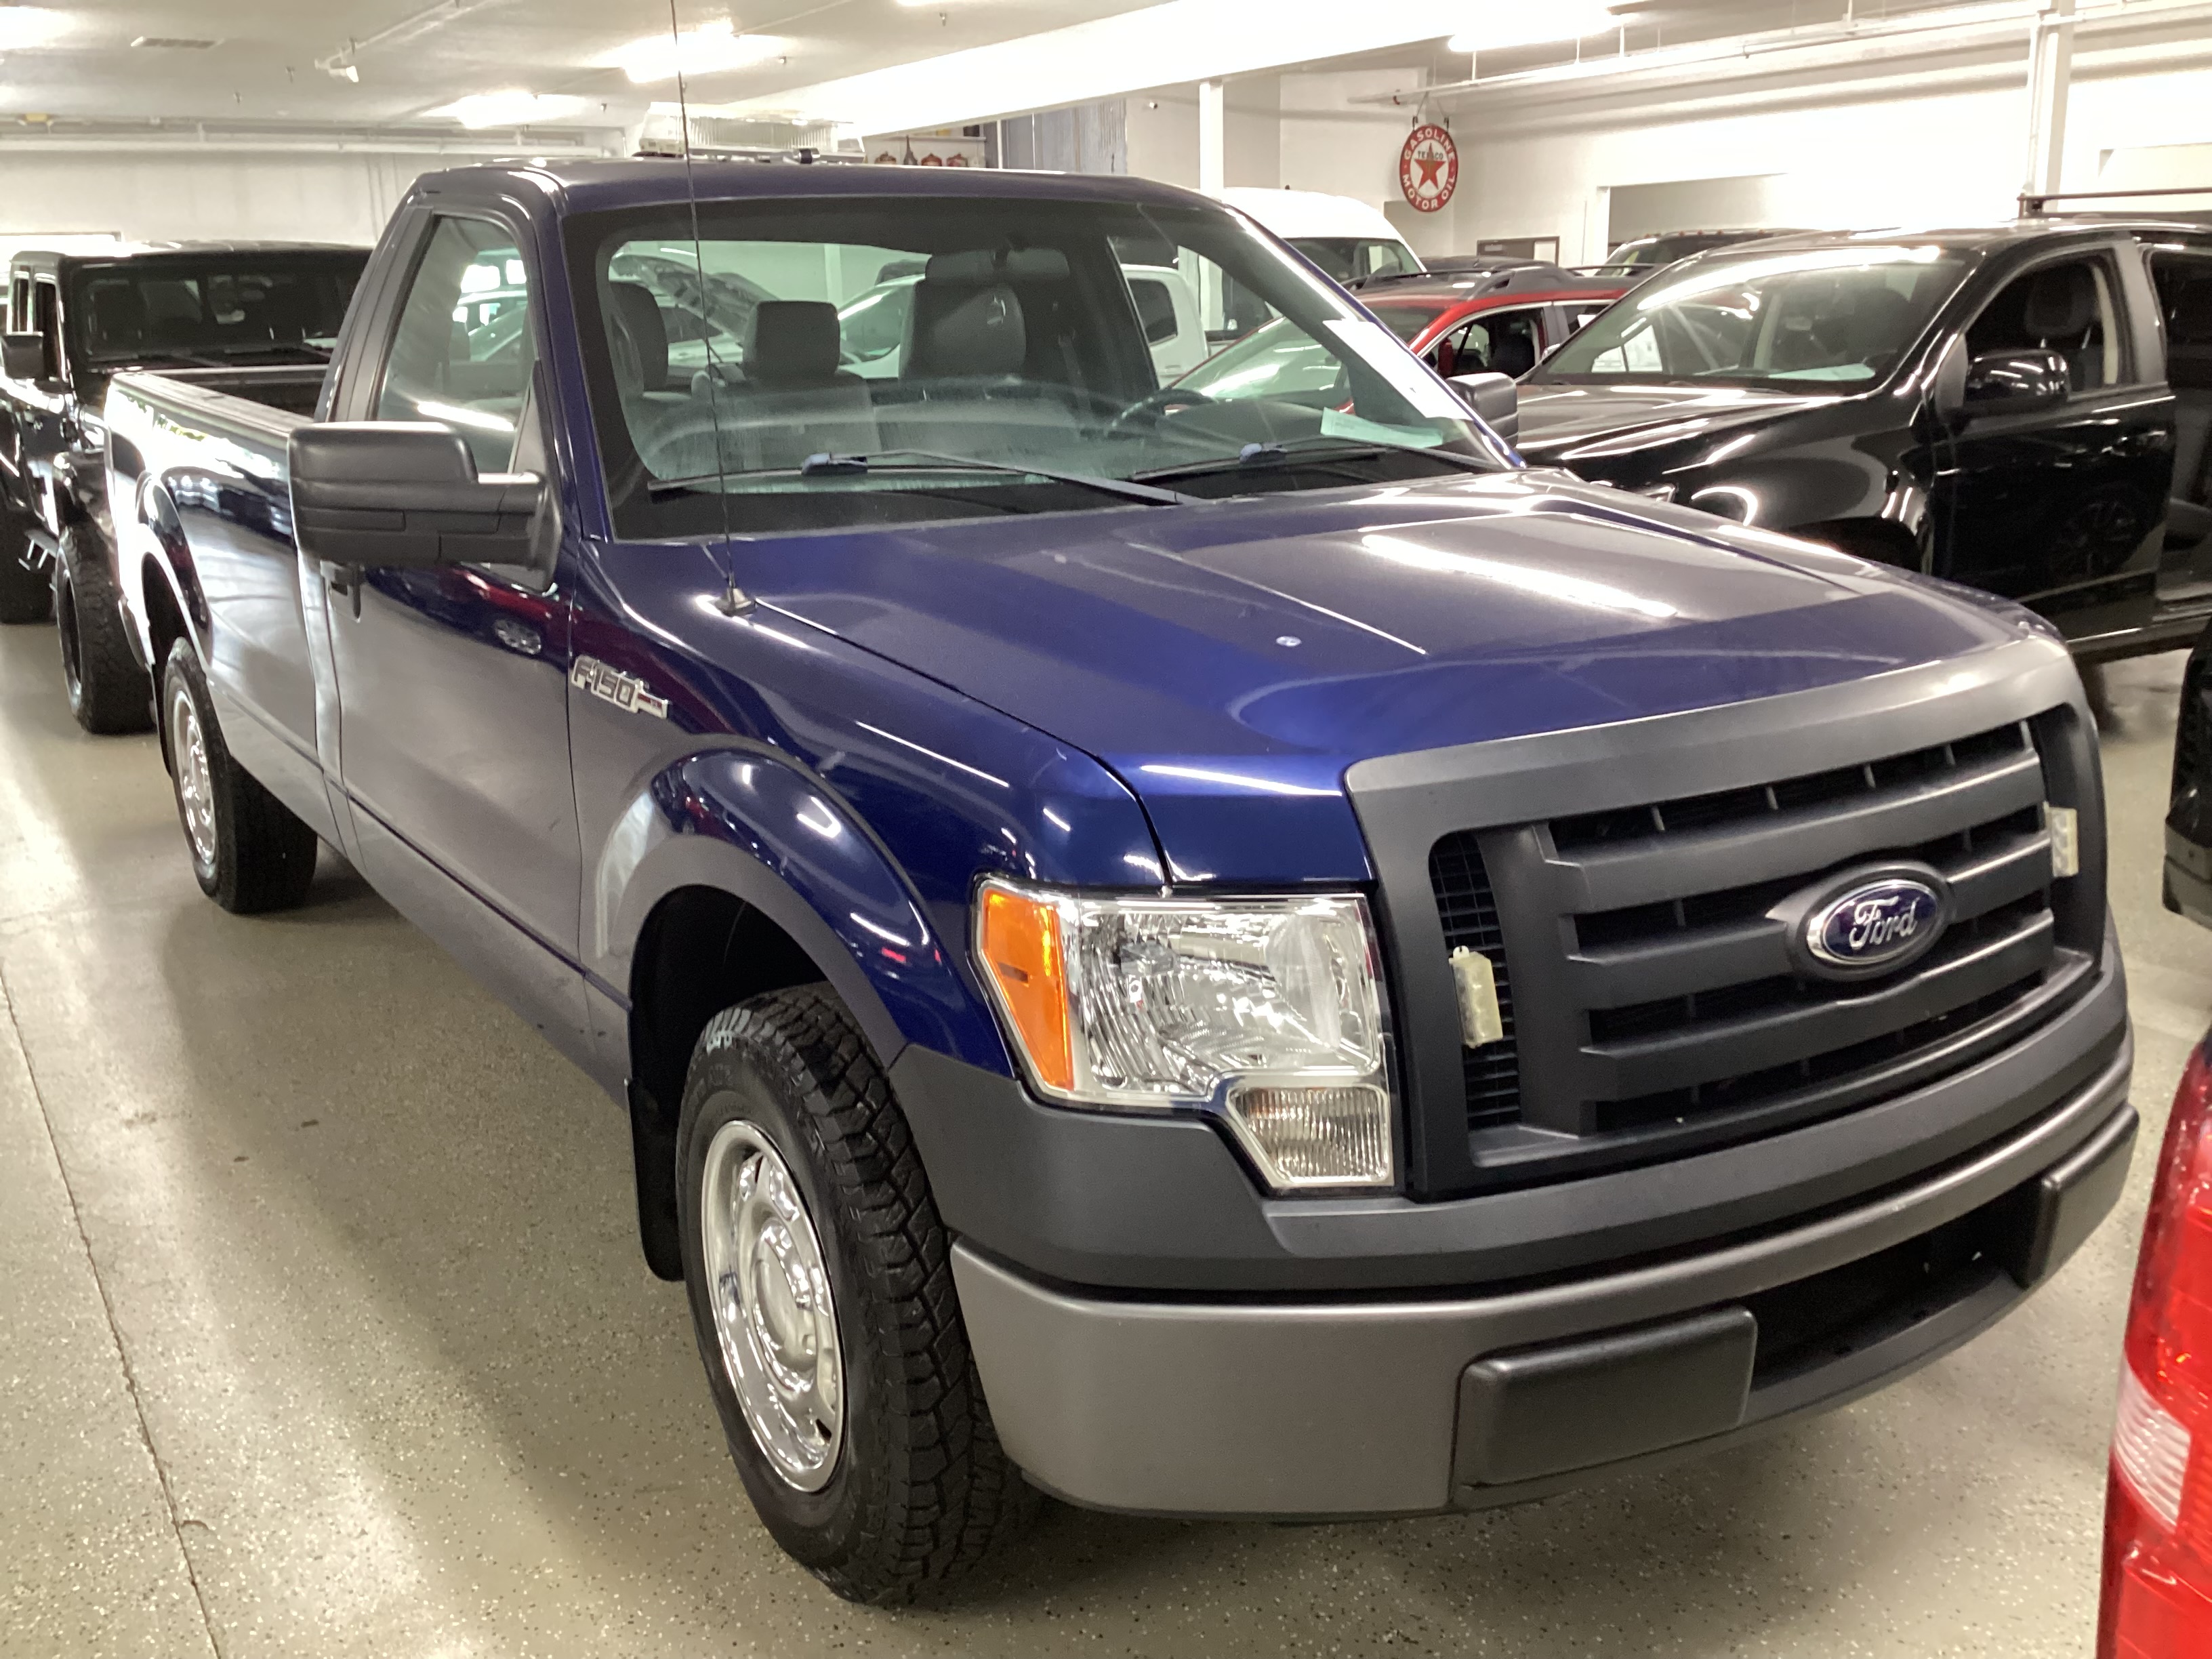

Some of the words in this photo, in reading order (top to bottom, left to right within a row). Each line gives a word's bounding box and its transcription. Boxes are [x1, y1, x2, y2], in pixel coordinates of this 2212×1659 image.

[1404, 128, 1456, 163] GASOLINE
[1403, 173, 1438, 210] MOTOR
[1441, 176, 1456, 201] OIL
[1849, 895, 1921, 950] Ford
